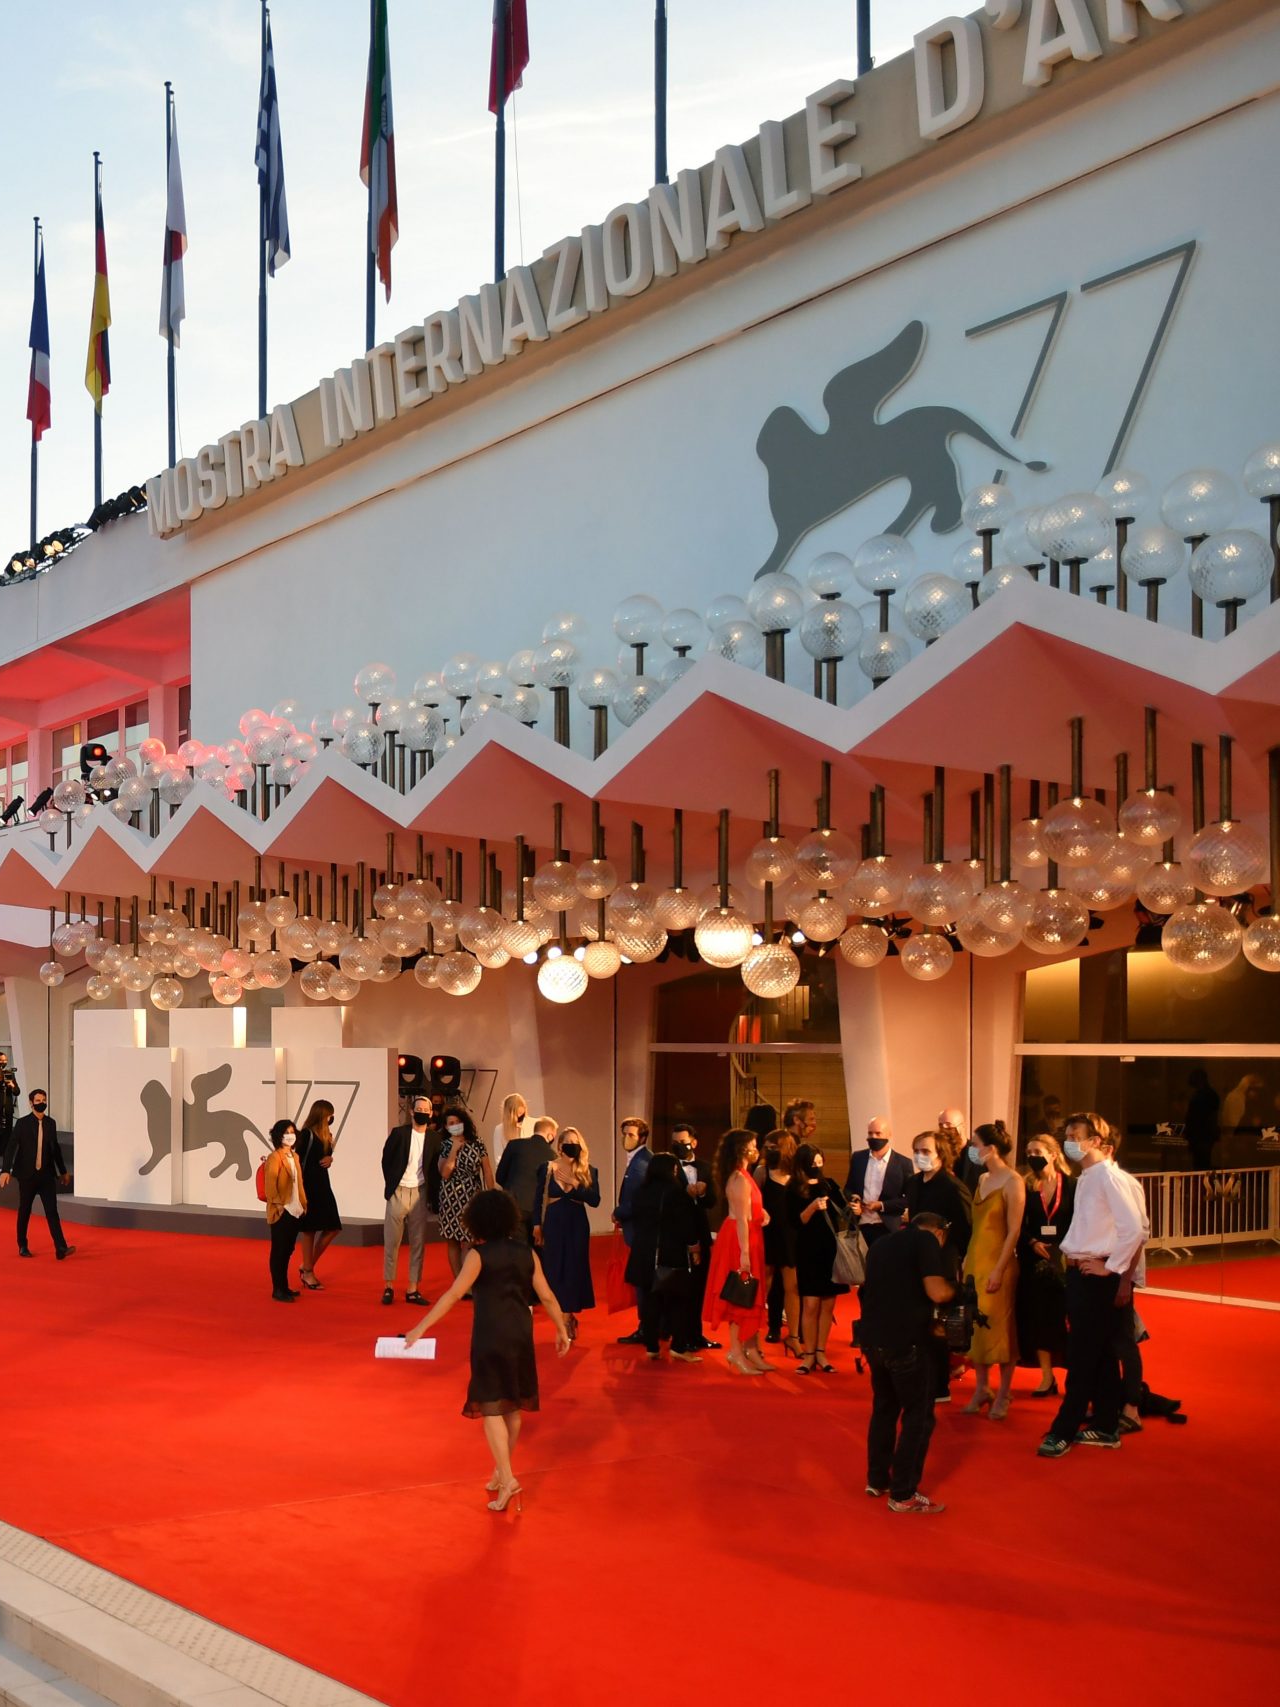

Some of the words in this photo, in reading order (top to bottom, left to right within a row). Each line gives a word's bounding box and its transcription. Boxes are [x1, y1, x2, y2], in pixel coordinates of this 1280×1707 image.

[146, 404, 304, 538] MOSTRA
[320, 79, 862, 447] INTERNAZIONALE
[964, 239, 1198, 484] 77
[261, 1080, 361, 1154] 77
